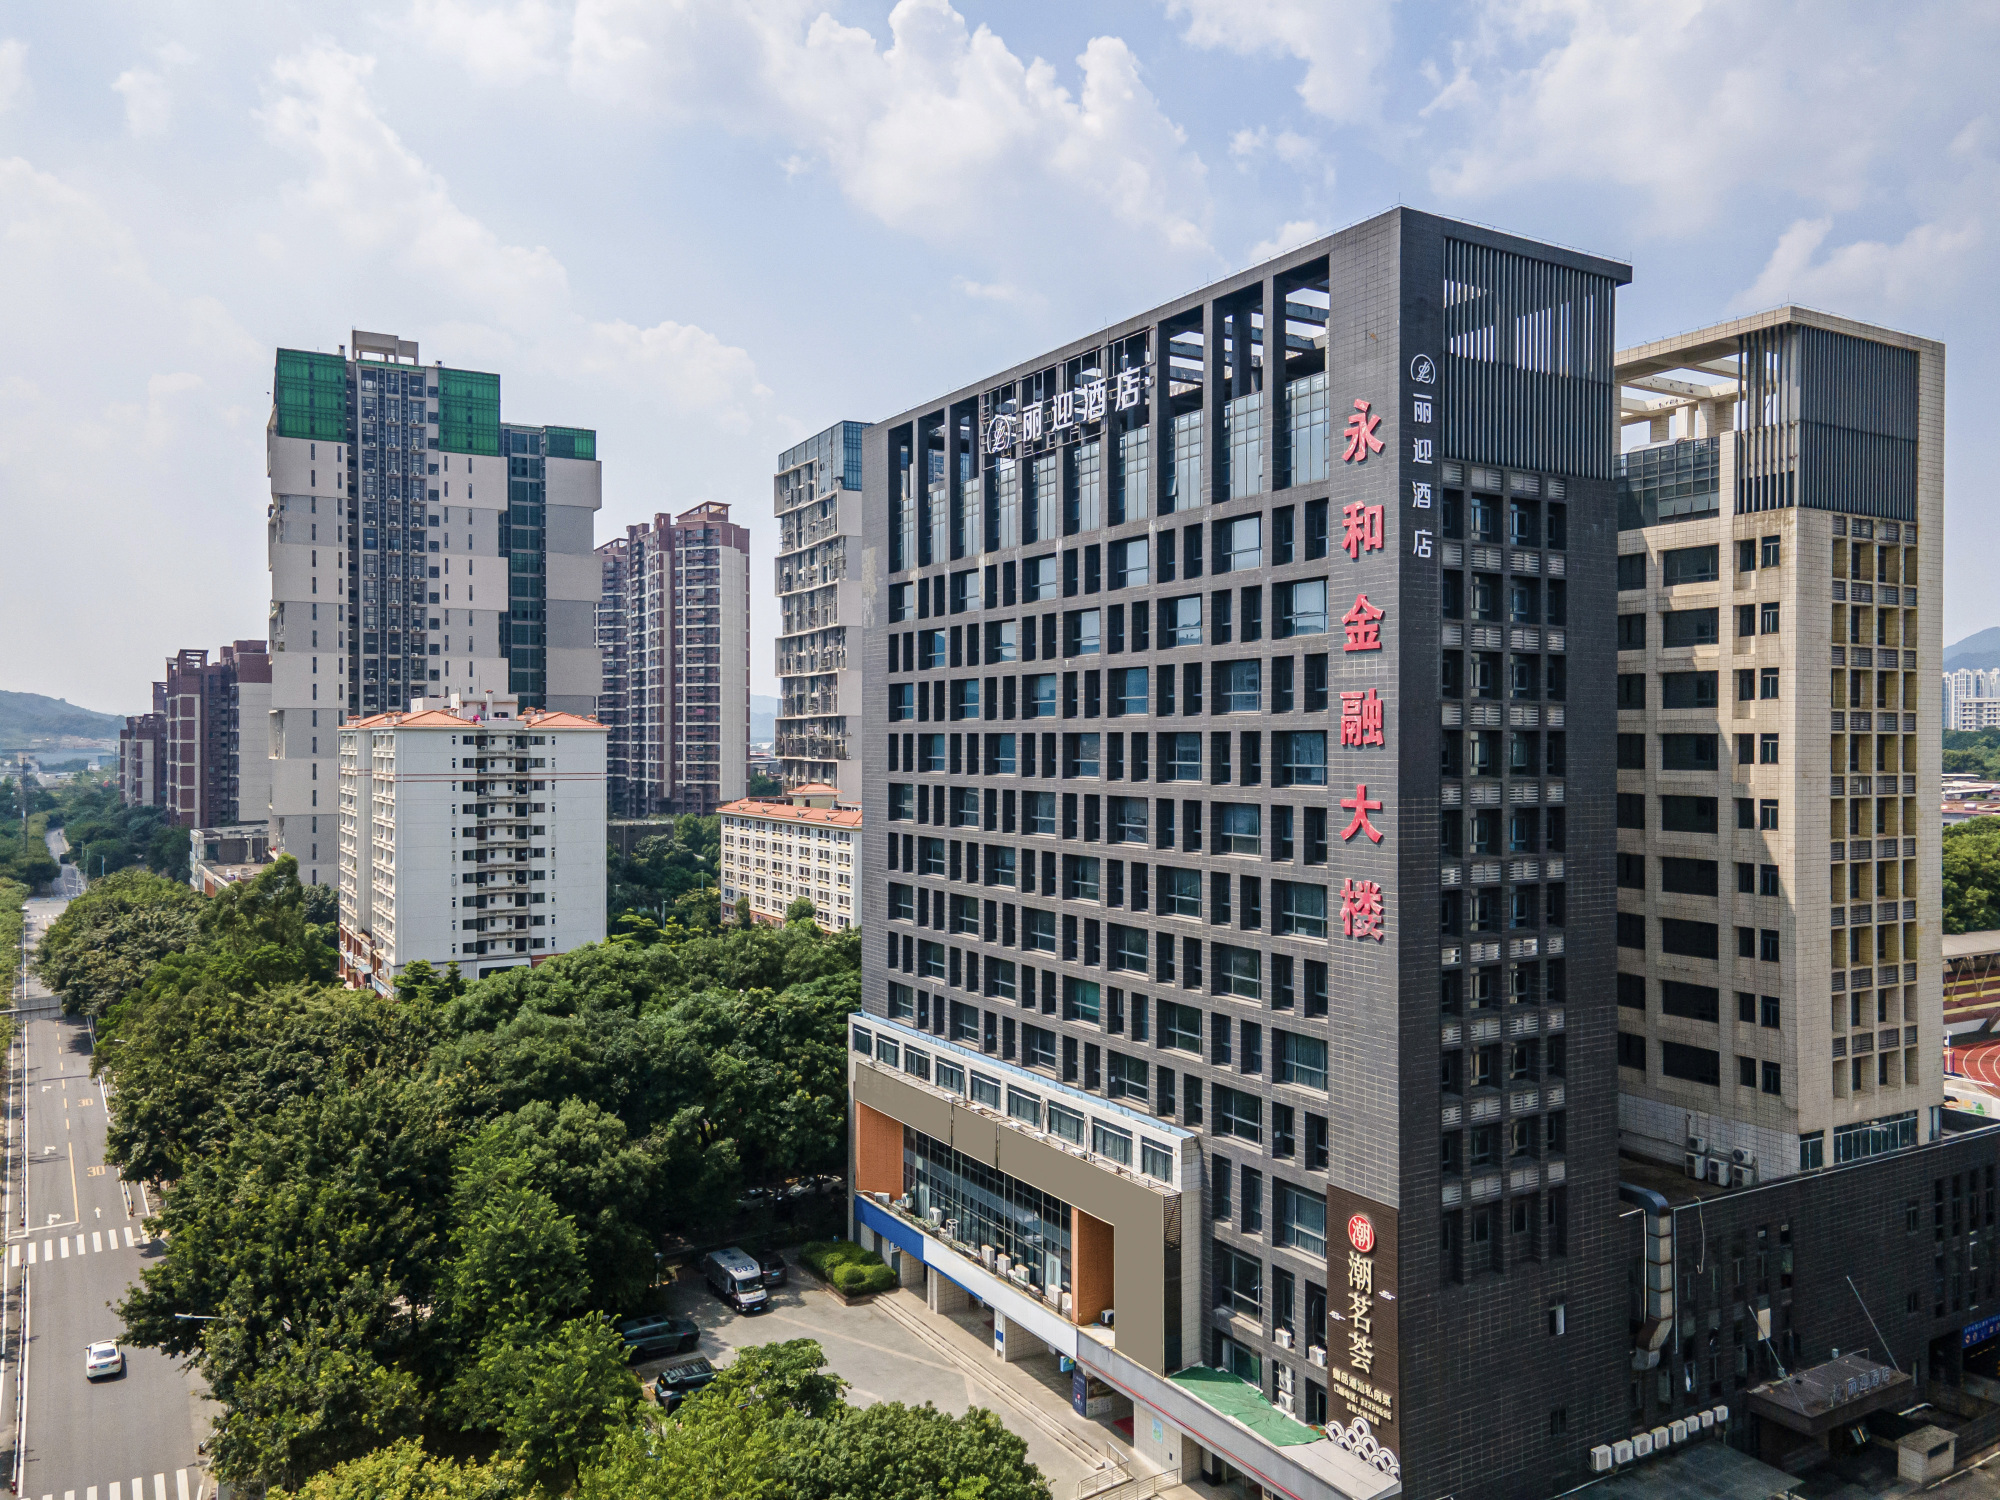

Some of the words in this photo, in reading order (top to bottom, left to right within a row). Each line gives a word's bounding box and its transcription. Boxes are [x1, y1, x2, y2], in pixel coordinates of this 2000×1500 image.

[1023, 367, 1141, 442] 丽迎酒店
[1413, 393, 1433, 558] 丽迎酒店
[1340, 398, 1385, 941] 永和金融大楼
[78, 1098, 94, 1107] 30
[87, 1165, 106, 1177] 30
[1352, 1218, 1371, 1250] 潮
[735, 1265, 755, 1273] 603
